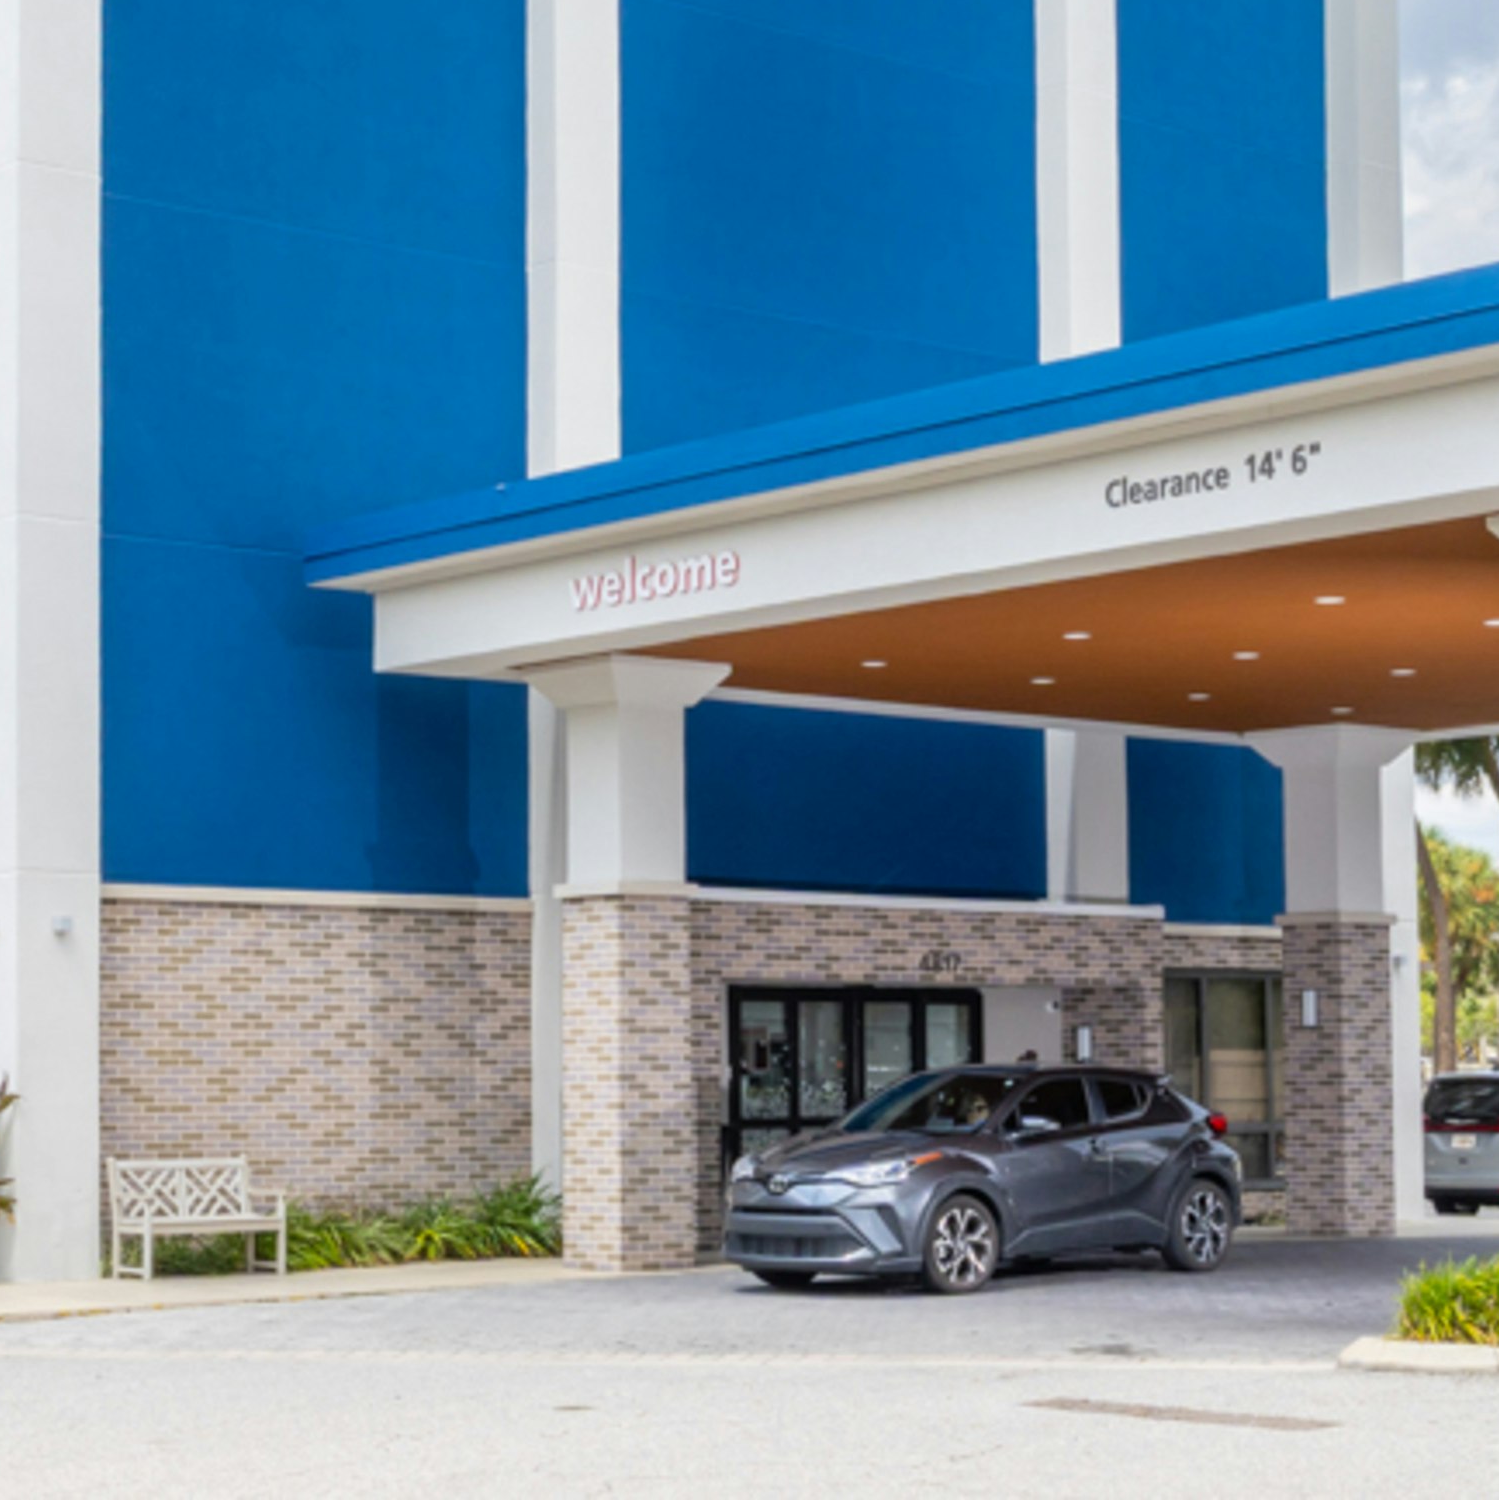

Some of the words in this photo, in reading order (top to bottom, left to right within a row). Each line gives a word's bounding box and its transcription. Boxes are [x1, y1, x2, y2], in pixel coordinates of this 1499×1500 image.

[1105, 466, 1230, 508] Clearance
[1244, 450, 1283, 483] 14'
[568, 550, 741, 612] welcome
